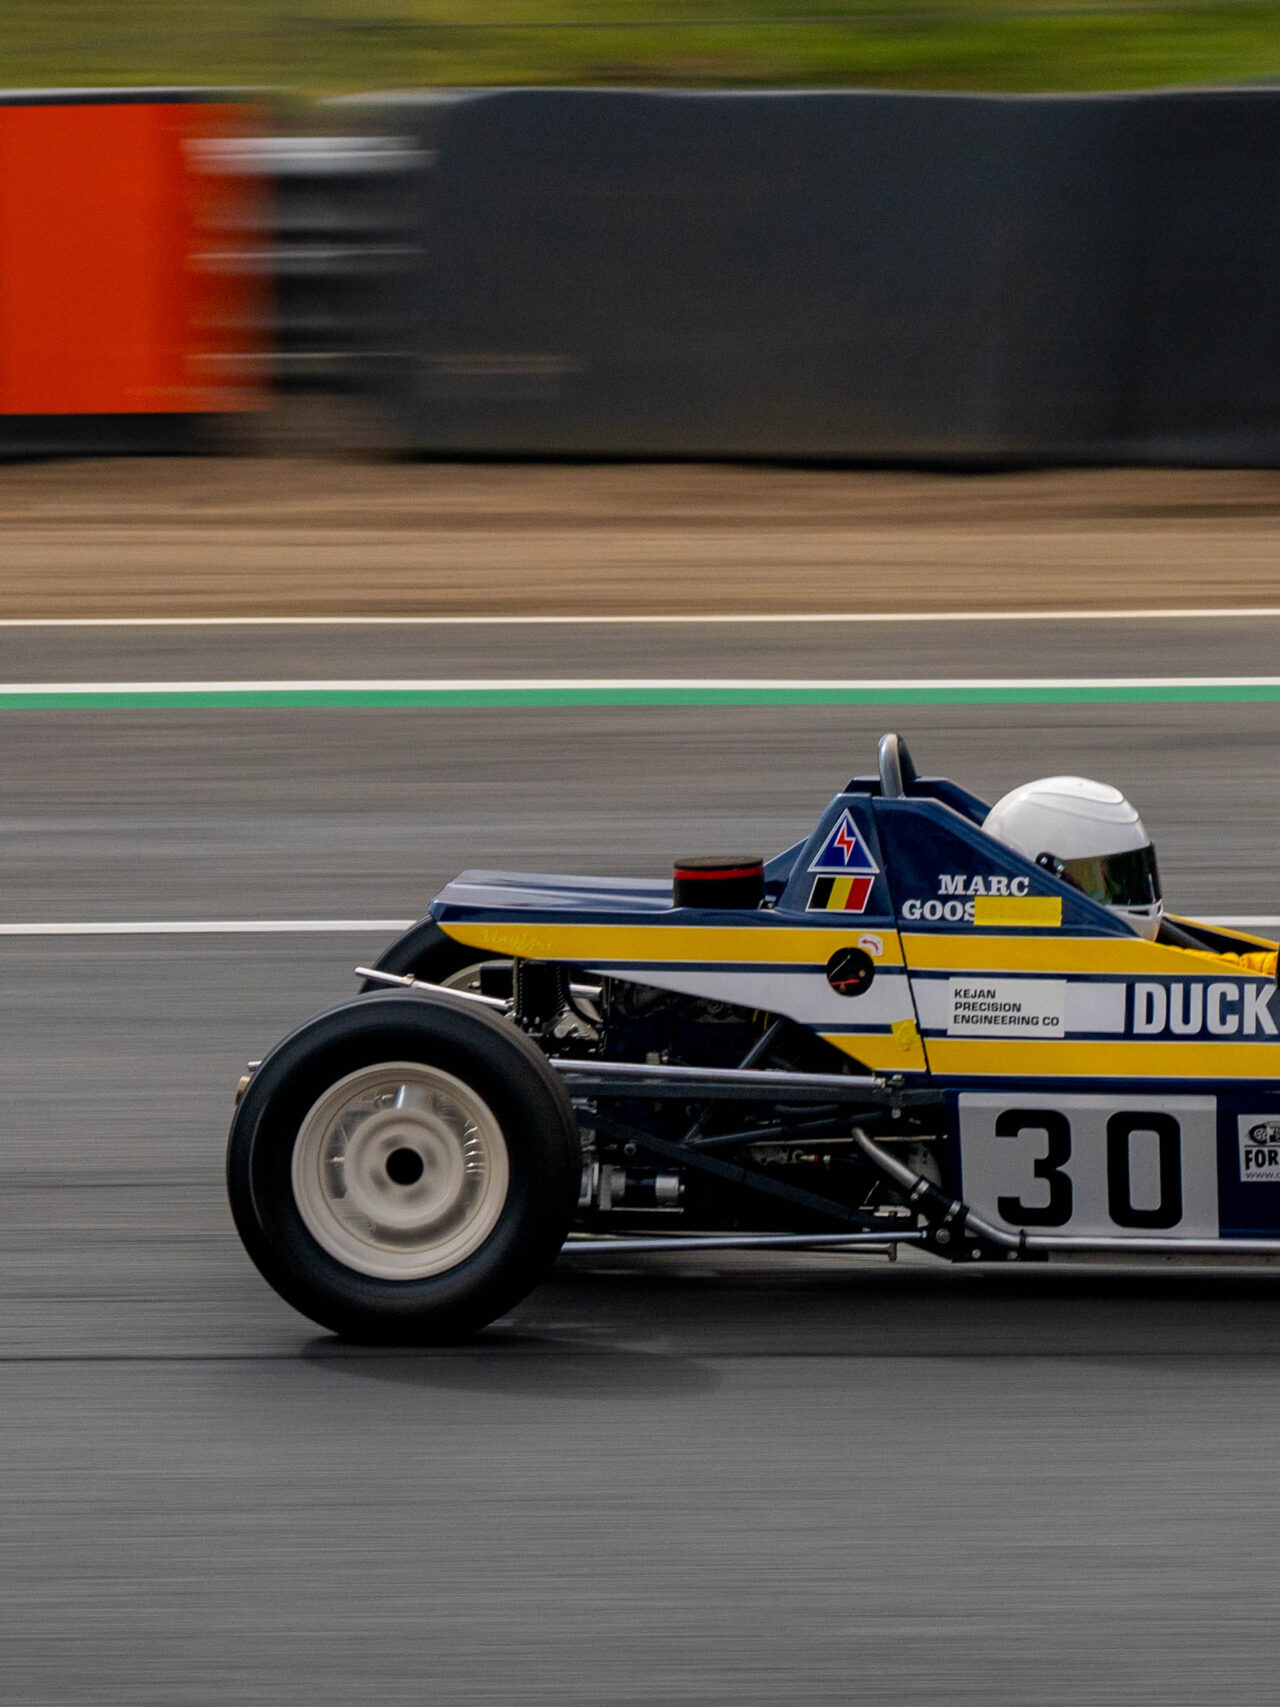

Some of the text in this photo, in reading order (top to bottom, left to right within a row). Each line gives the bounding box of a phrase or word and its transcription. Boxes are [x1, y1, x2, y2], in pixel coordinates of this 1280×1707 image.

[938, 874, 1029, 897] MARC
[954, 988, 996, 999] KEJAN
[954, 1001, 1022, 1012] PRECISION
[953, 1014, 1060, 1026] ENGINEERING CO
[994, 1108, 1183, 1230] 30
